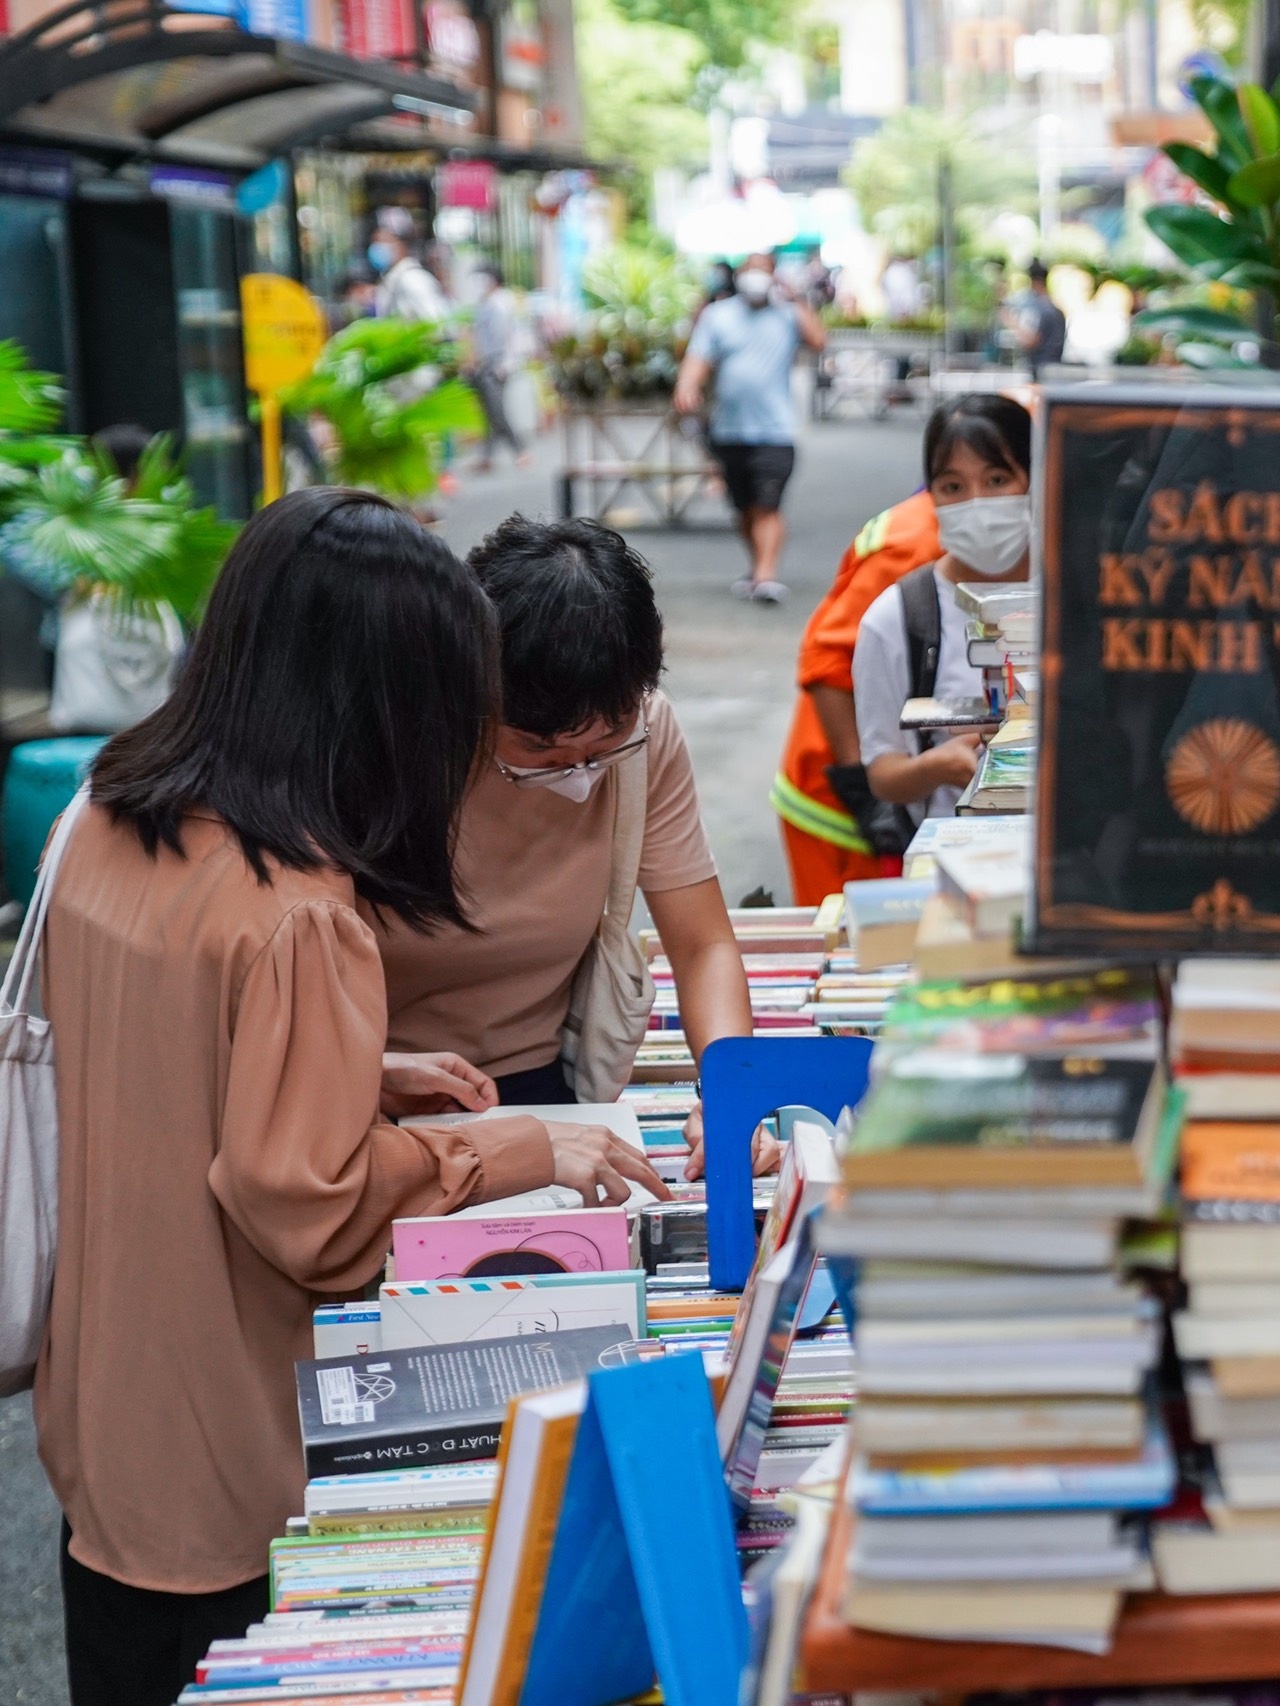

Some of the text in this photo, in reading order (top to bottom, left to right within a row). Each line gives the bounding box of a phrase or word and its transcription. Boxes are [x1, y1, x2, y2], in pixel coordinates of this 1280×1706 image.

[1097, 547, 1175, 608] KỸ
[1100, 616, 1262, 674] KINH
[486, 1227, 509, 1235] NGUYỄN
[347, 1313, 364, 1321] First
[459, 1434, 502, 1448] HUẬT
[376, 1445, 414, 1459] TÂM
